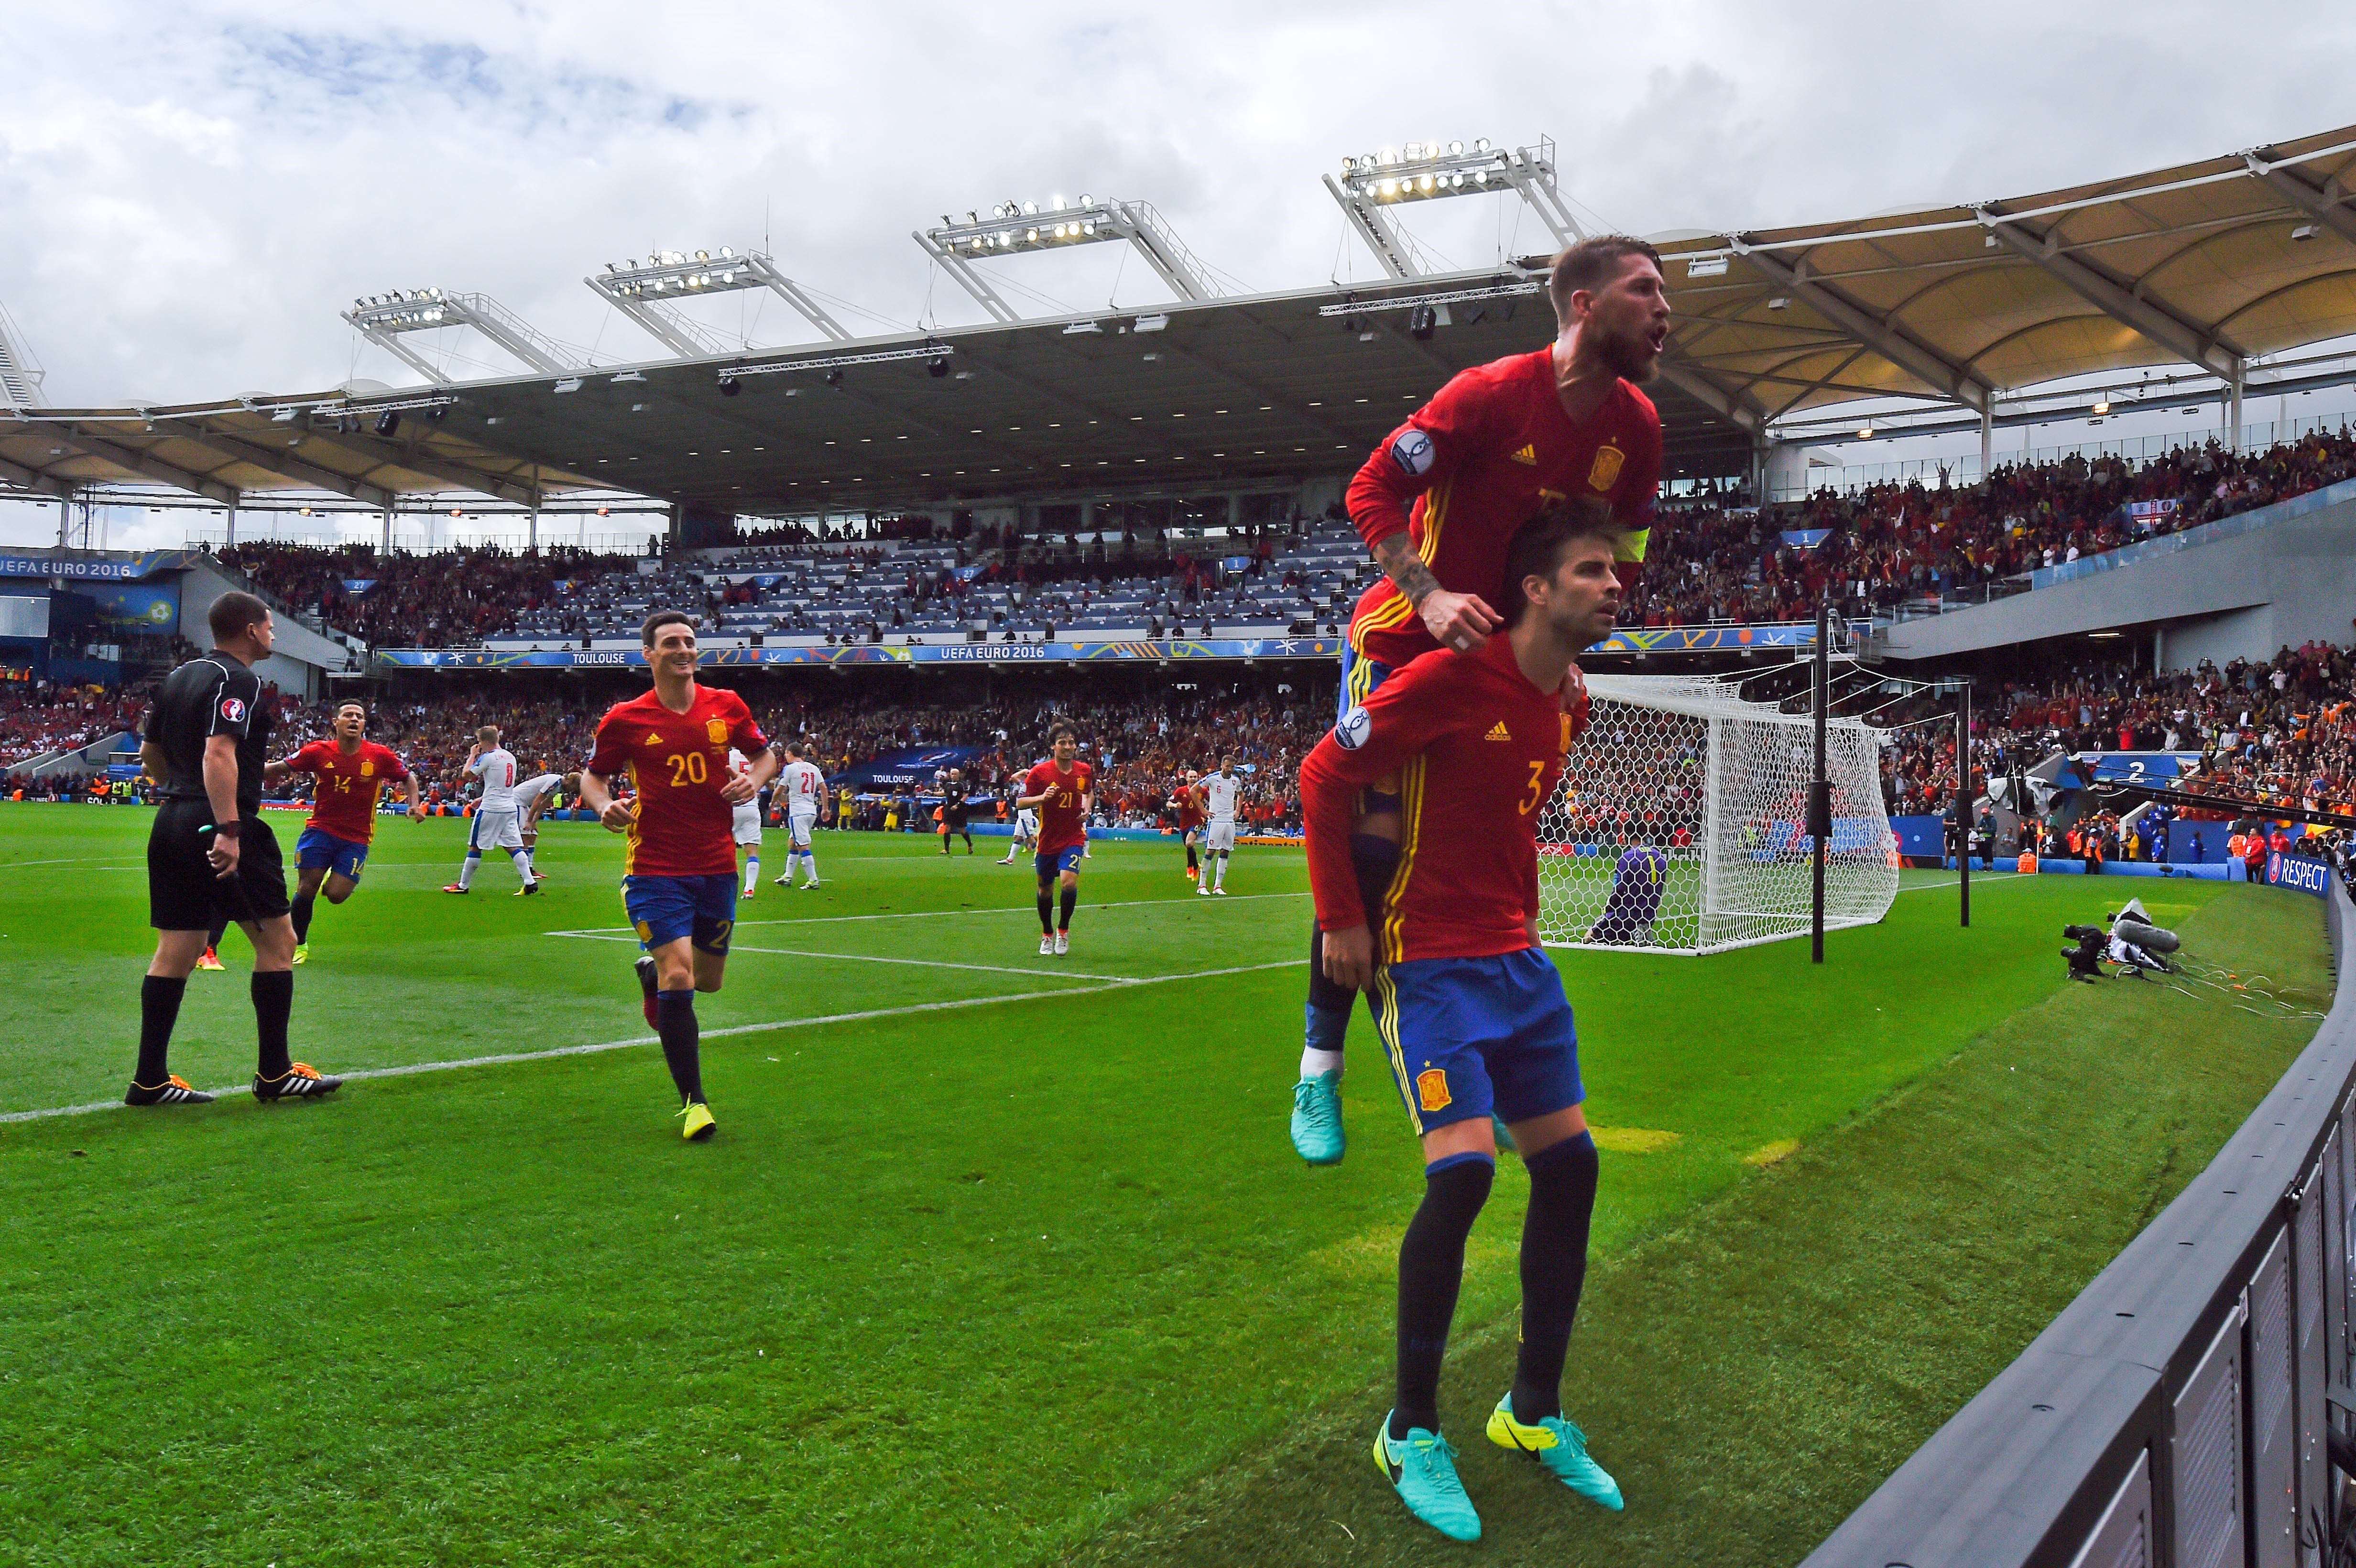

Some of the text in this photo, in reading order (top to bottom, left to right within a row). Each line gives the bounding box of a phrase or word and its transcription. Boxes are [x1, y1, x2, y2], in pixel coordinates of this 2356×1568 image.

[42, 562, 86, 574] EURO
[91, 564, 131, 577] 2016
[573, 653, 625, 664] TOULOUSE
[941, 646, 1045, 659] UEFA EURO 2016
[505, 762, 513, 787] 8
[667, 751, 707, 787] 20
[873, 774, 914, 784] TOULOUSE
[2129, 762, 2145, 783] 2
[335, 775, 351, 794] 14
[801, 772, 815, 794] 21
[1518, 761, 1545, 815] 3
[1059, 792, 1072, 808] 21
[2281, 858, 2326, 891] RESPECT
